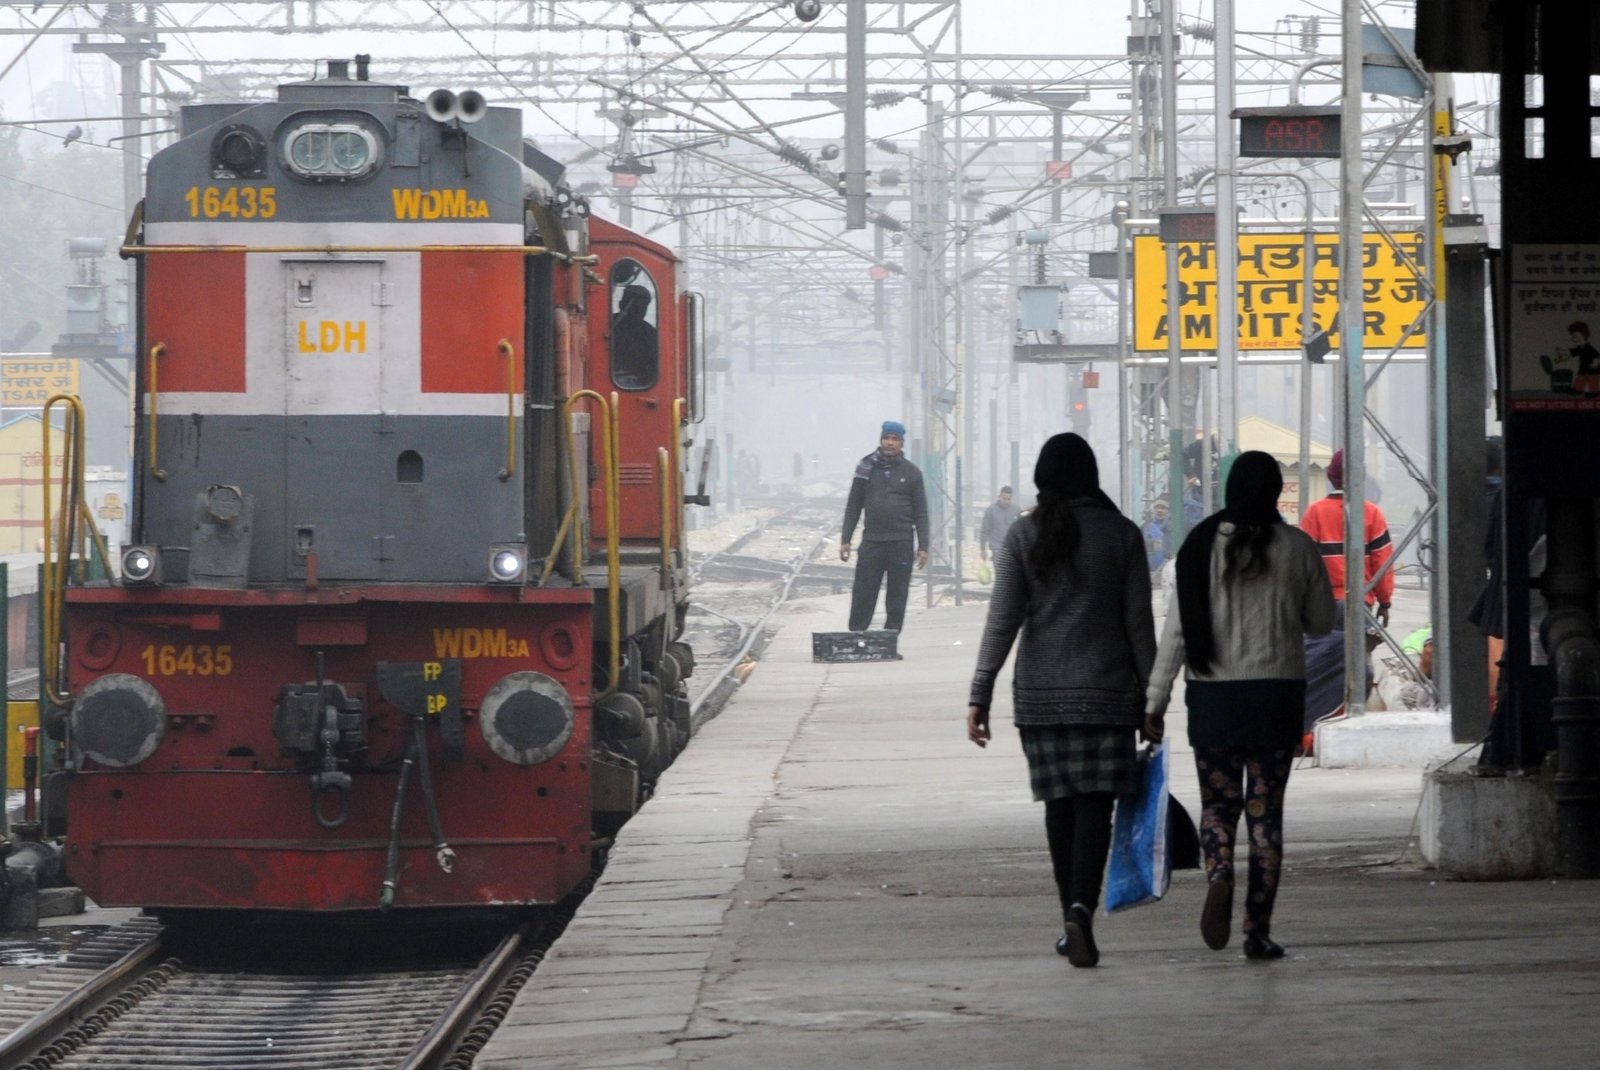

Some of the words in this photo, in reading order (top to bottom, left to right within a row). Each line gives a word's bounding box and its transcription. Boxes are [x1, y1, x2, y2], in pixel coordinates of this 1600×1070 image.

[1264, 117, 1324, 149] ASR
[185, 187, 277, 218] 16435
[298, 320, 367, 353] LDH
[141, 644, 233, 676] 16435
[423, 662, 442, 681] FP
[426, 694, 448, 714] BP
